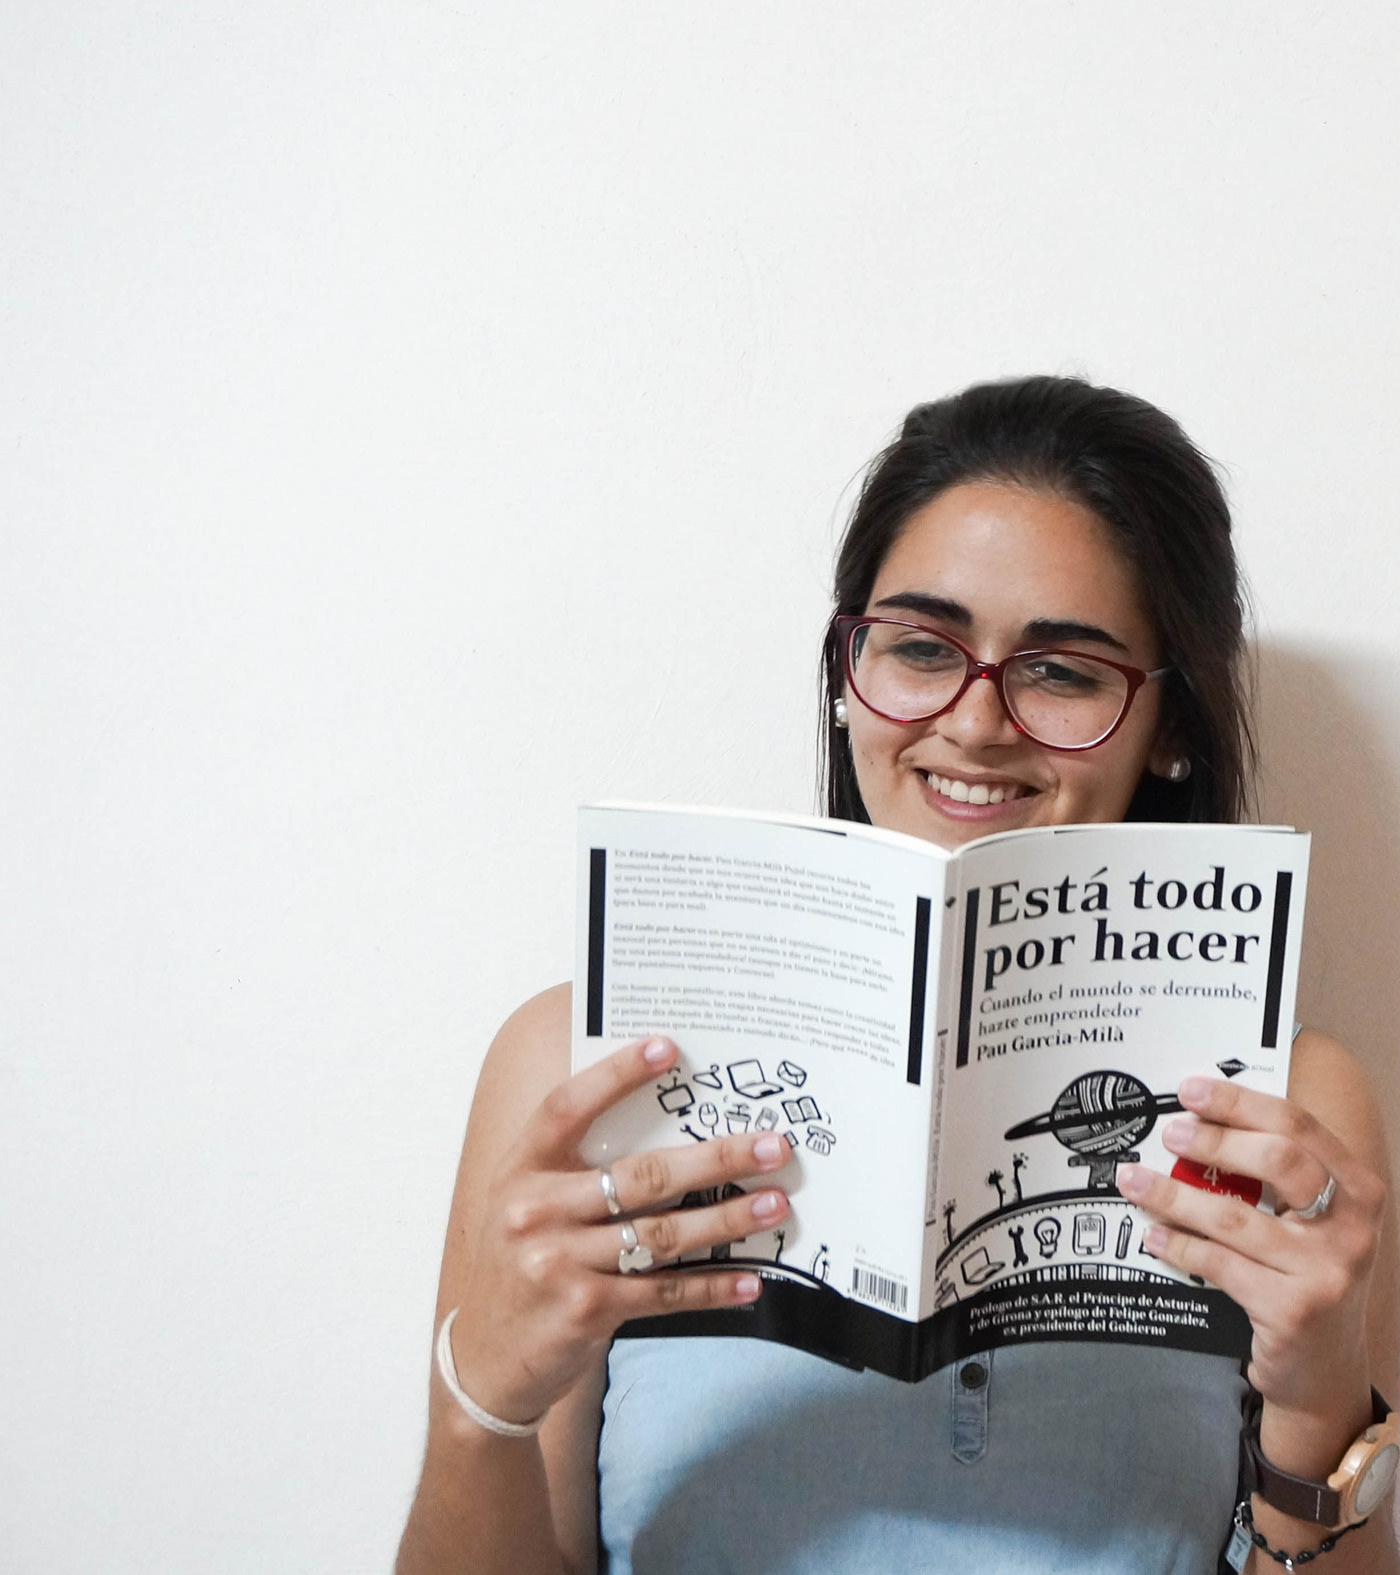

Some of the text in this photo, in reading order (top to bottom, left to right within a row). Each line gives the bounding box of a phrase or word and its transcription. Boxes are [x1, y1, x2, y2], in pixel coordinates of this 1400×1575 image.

[987, 865, 1262, 928] Está todo
[983, 917, 1260, 993] por hacer
[979, 979, 1257, 1015] Cuando el mundo se derrumbe,
[978, 1002, 1143, 1037] hazte emprendedor
[976, 1039, 1008, 1061] Pau
[969, 1305, 1209, 1336] y de Girona y epílogo de Felipe González,
[970, 1291, 1209, 1320] Prólogo de S.A.R. el Príncipe de Asturias
[1003, 1318, 1167, 1337] ex presidente del Gobierno
